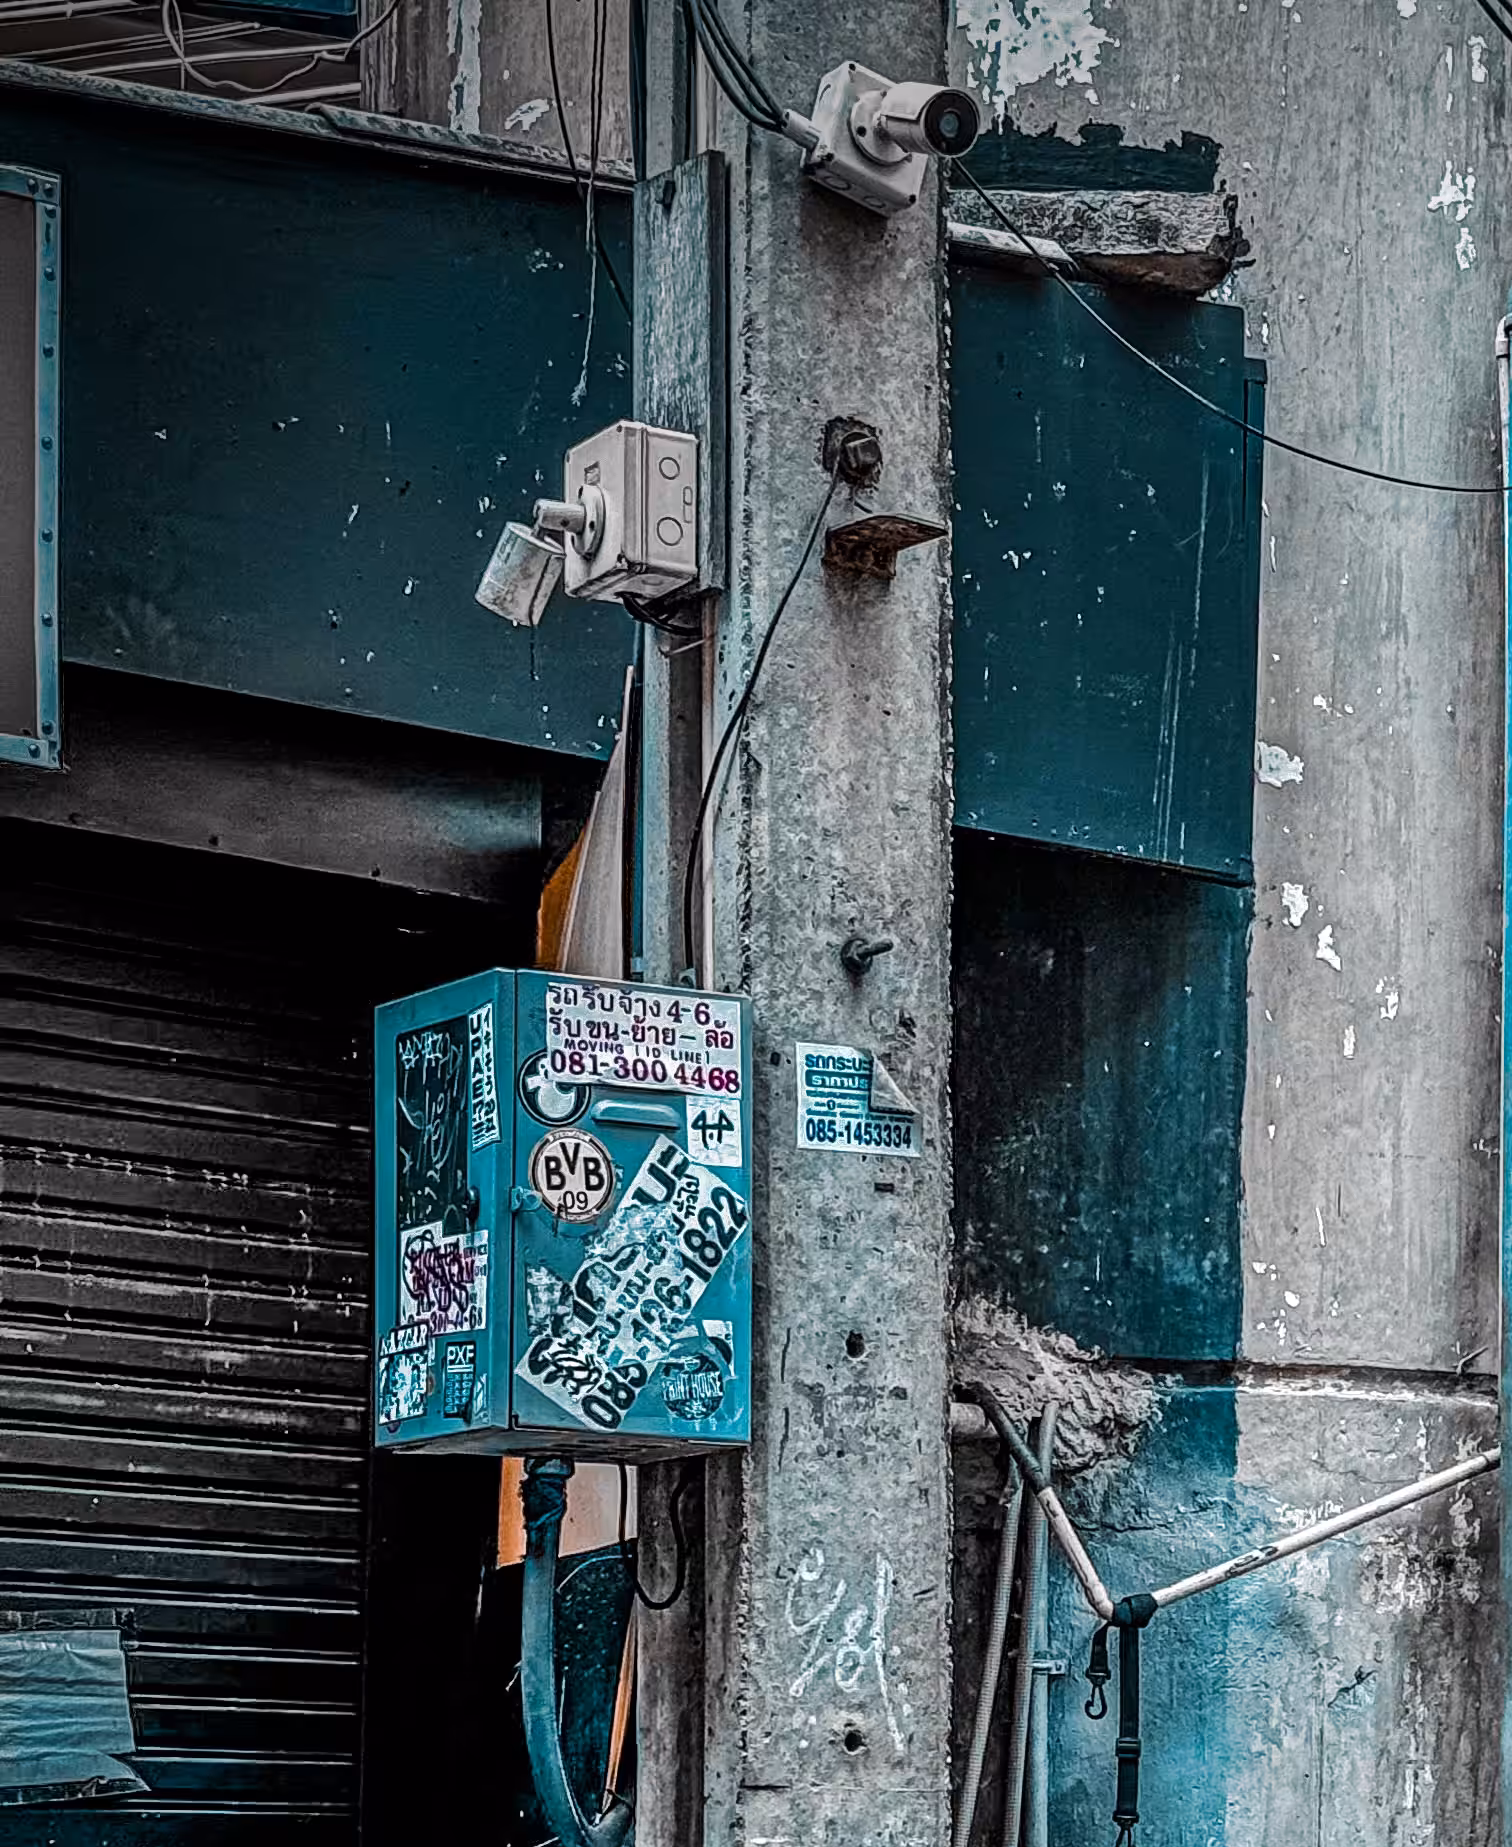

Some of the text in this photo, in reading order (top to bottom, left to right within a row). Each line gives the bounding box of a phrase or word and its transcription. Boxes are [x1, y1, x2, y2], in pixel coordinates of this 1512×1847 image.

[667, 1000, 710, 1025] 4-6
[563, 1038, 625, 1055] MOVING
[705, 1020, 734, 1049] ล้อ
[805, 1117, 912, 1149] 085-1453334
[544, 1142, 605, 1191] BVB
[563, 1190, 588, 1210] 09
